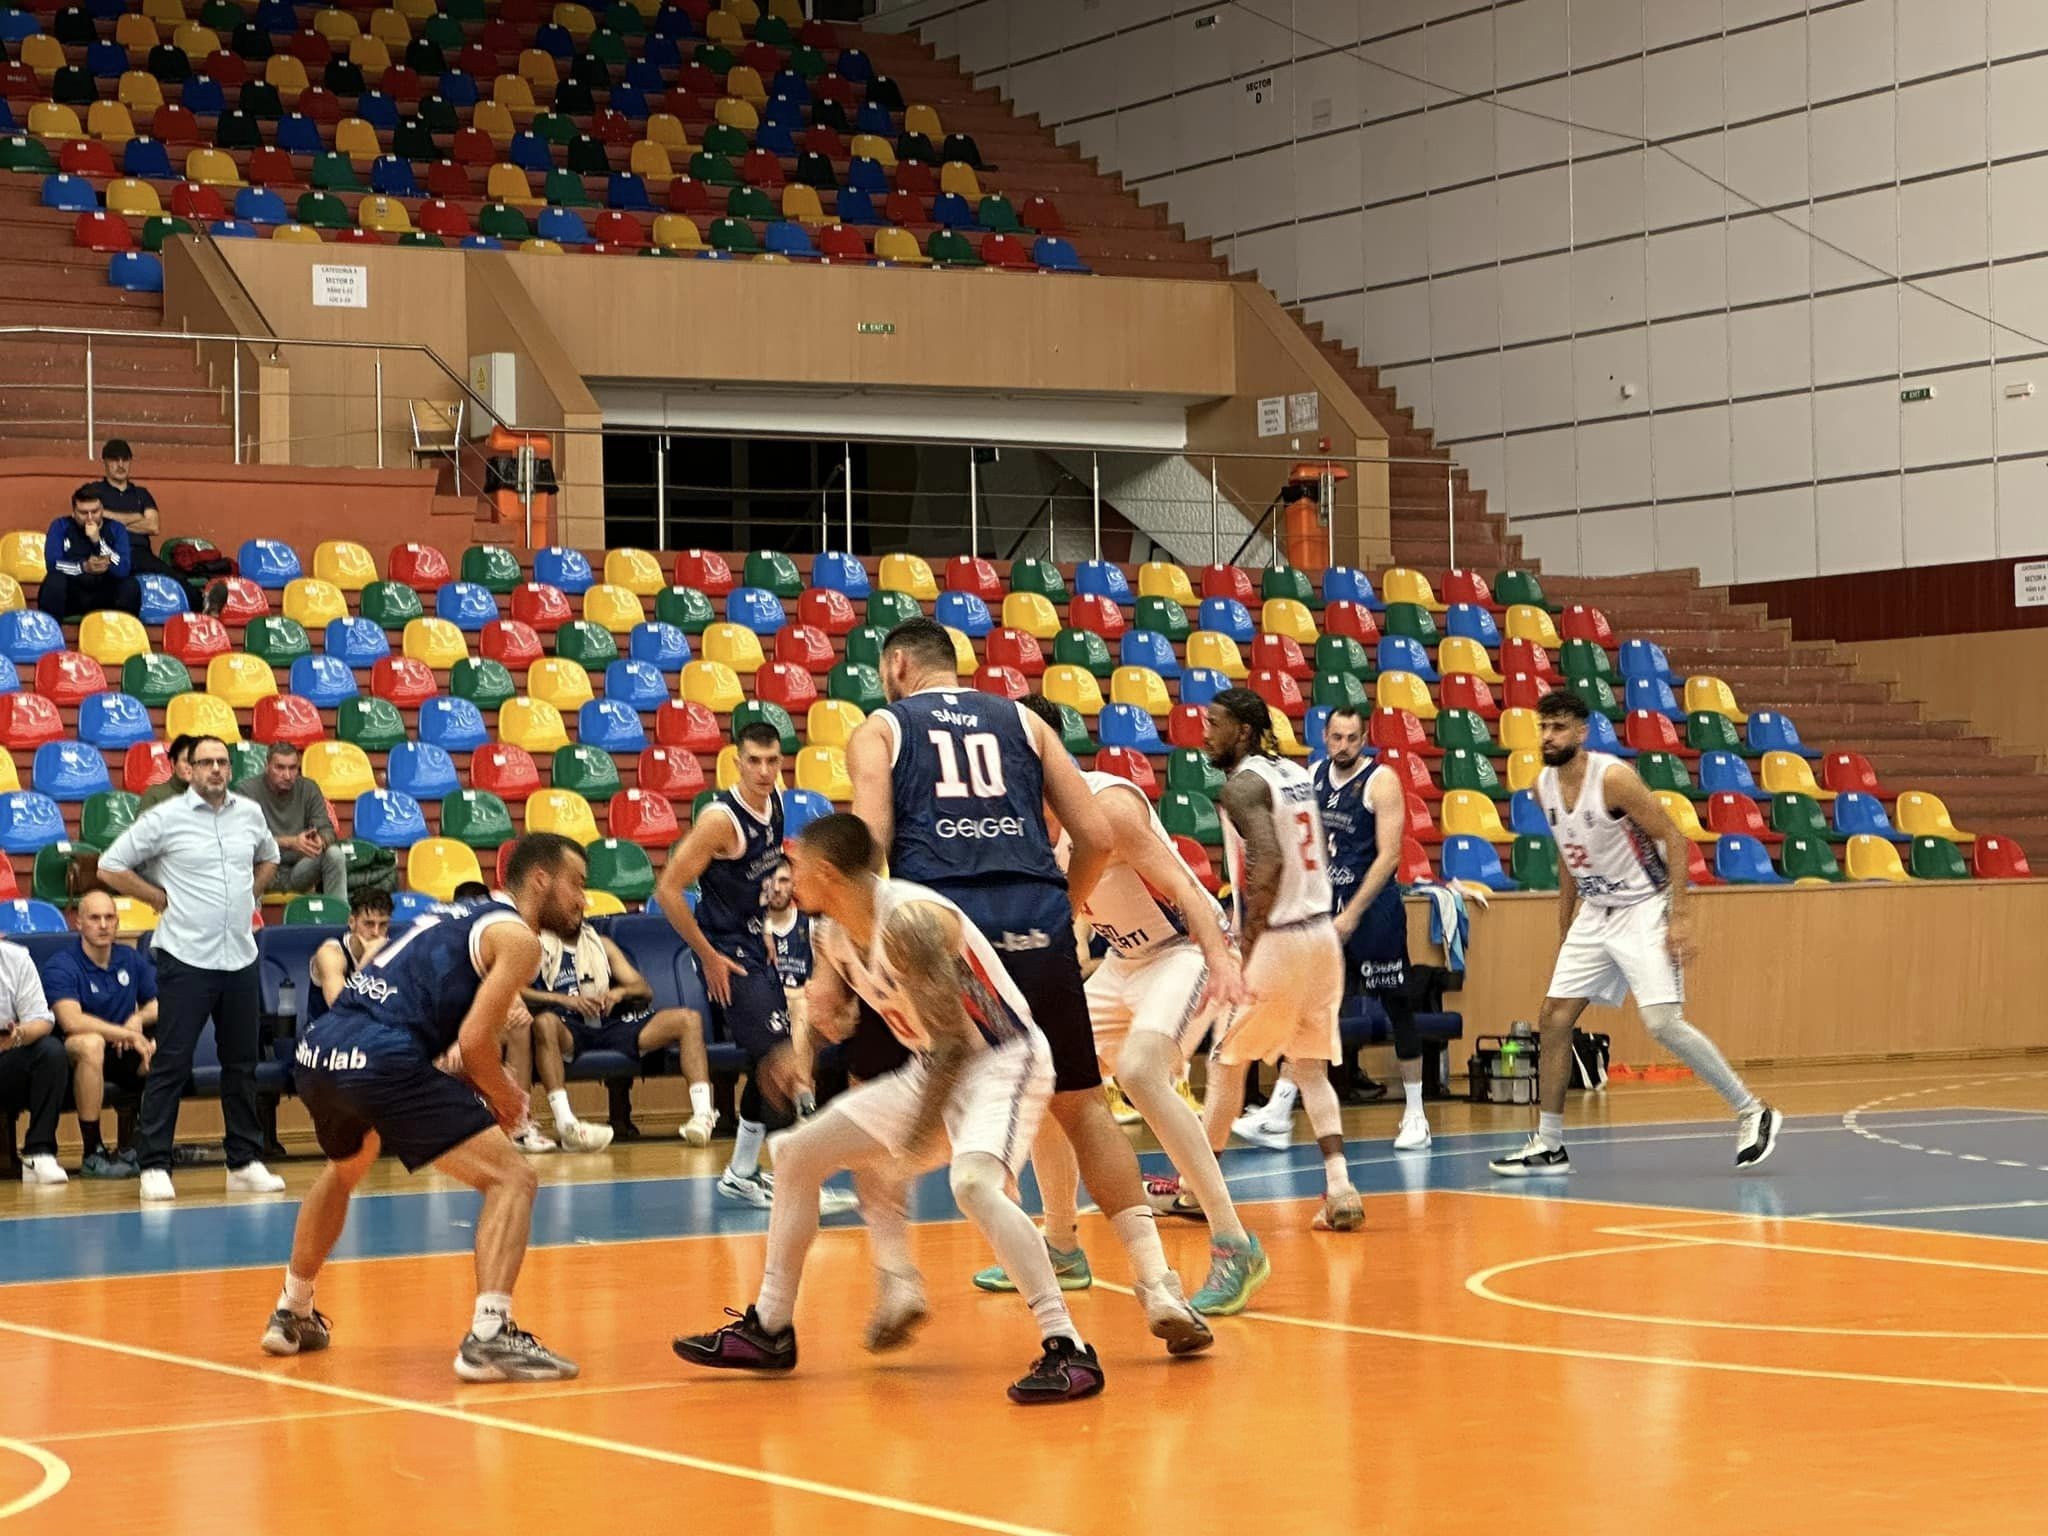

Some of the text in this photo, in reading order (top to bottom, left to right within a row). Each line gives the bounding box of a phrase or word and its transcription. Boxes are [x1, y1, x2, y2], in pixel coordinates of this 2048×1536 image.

[1246, 78, 1271, 92] SECTOR
[1255, 92, 1262, 104] D
[927, 729, 1007, 798] 10
[1295, 810, 1319, 871] 2
